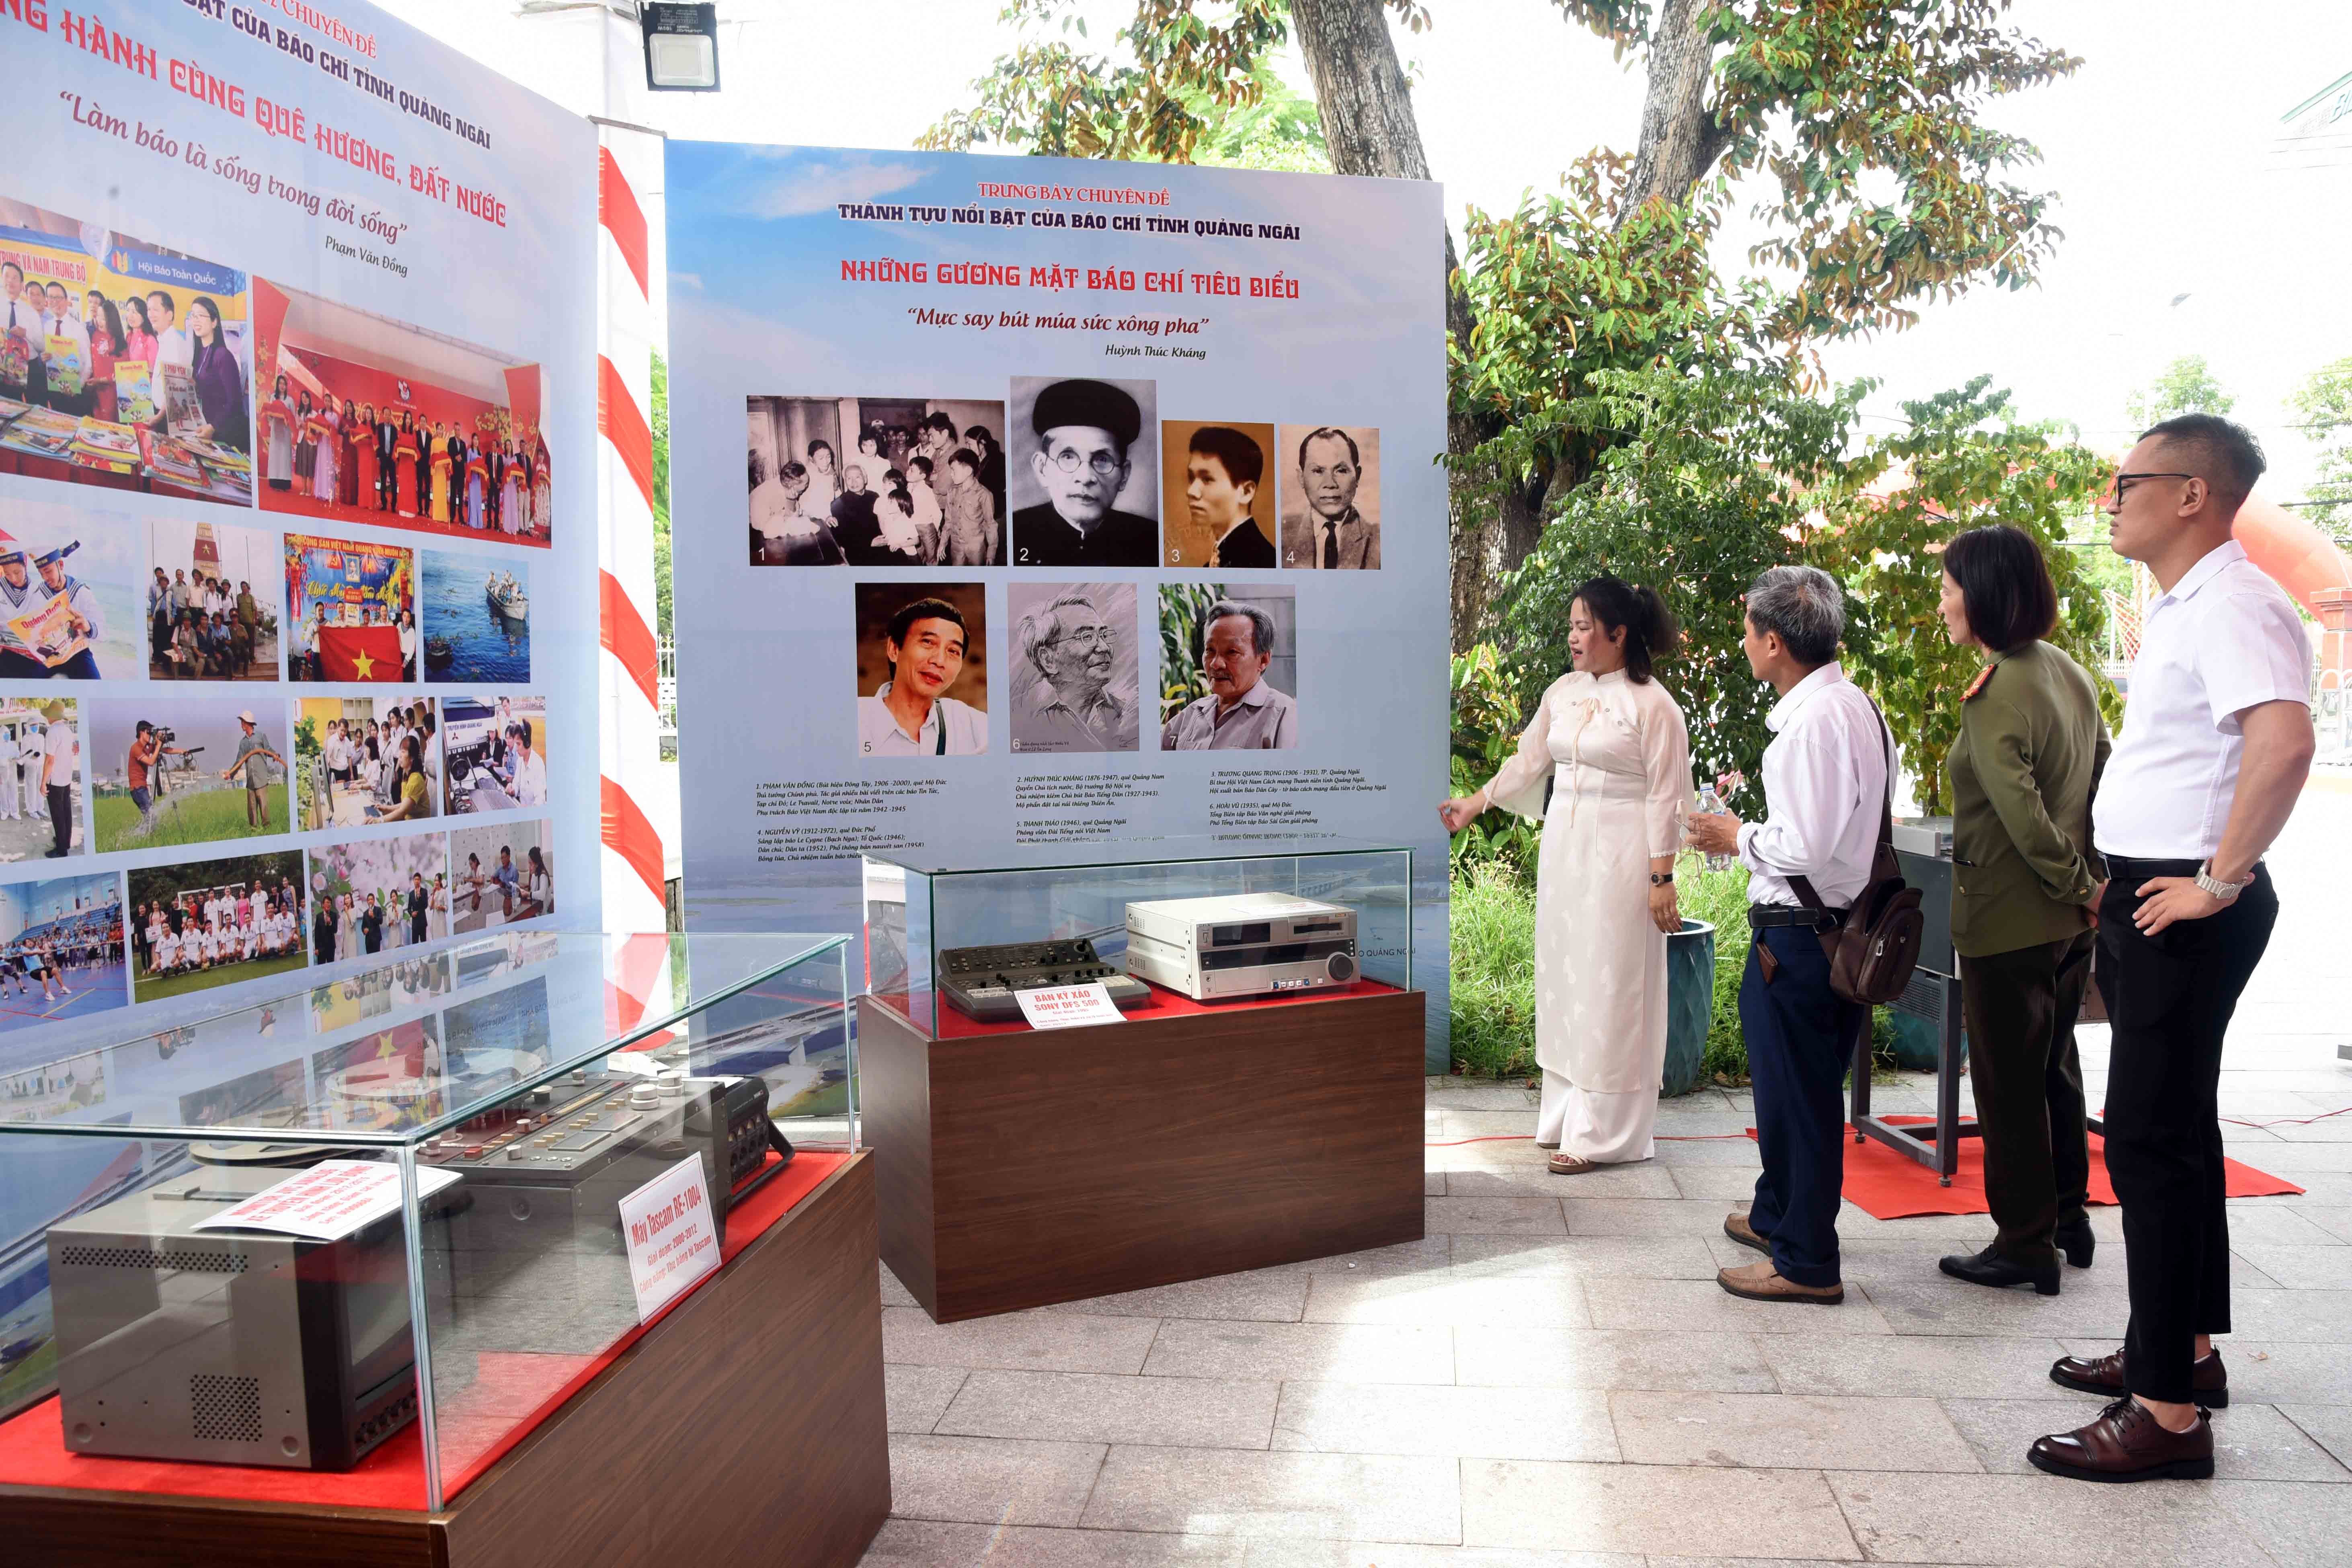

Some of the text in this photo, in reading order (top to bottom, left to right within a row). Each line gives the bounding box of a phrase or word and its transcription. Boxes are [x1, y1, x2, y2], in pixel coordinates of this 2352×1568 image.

[283, 0, 377, 59] CHUYÊN ĐỀ
[232, 8, 271, 44] CỦA
[276, 28, 314, 63] BÁO
[320, 51, 349, 81] CHÍ
[353, 66, 394, 103] TỈNH
[400, 90, 452, 131] QUẢNG
[456, 118, 491, 150] NGÃI
[60, 9, 158, 81] HÀNH
[169, 58, 245, 118] CÙNG
[255, 96, 306, 144] QUÊ
[314, 122, 402, 187] HƯƠNG,
[409, 164, 450, 203] ĐẤT
[457, 185, 506, 228] NƯỚC
[60, 91, 408, 244] “Làm báo là sống trong đời sống”
[978, 183, 1170, 206] TRƯNG BÀY CHUYÊN ĐỀ
[838, 202, 1300, 241] THÀNH TỰU NỔI BẬT CỦA BÁO CHÍ TỈNH QUẢNG NGÃI
[325, 236, 408, 278] Phạm Văn Đồng
[34, 257, 50, 274] NAM
[51, 260, 74, 280] TRUNG
[76, 261, 86, 285] BỘ
[138, 261, 216, 285] Hội Báo Toàn Quốc
[841, 257, 1300, 299] NHỮNG GƯƠNG MẶT BÁO CHÍ TIÊU BIỂU
[908, 308, 1209, 337] “Mực say bút múa sức xông pha”
[1106, 344, 1207, 361] Huỳnh Thúc Kháng
[759, 548, 765, 561] 1
[1020, 548, 1028, 561] 2
[1172, 549, 1180, 562] 3
[1287, 551, 1295, 564] 4
[864, 741, 871, 753] 5
[1013, 738, 1020, 749] 6
[1169, 735, 1176, 747] 7
[1367, 947, 1395, 957] QUẢNG
[1034, 999, 1100, 1011] SONY DFS 500
[632, 1183, 702, 1248] Máy Tascam RE-1004
[694, 1234, 712, 1254] Tascam
[647, 1253, 658, 1266] Giai
